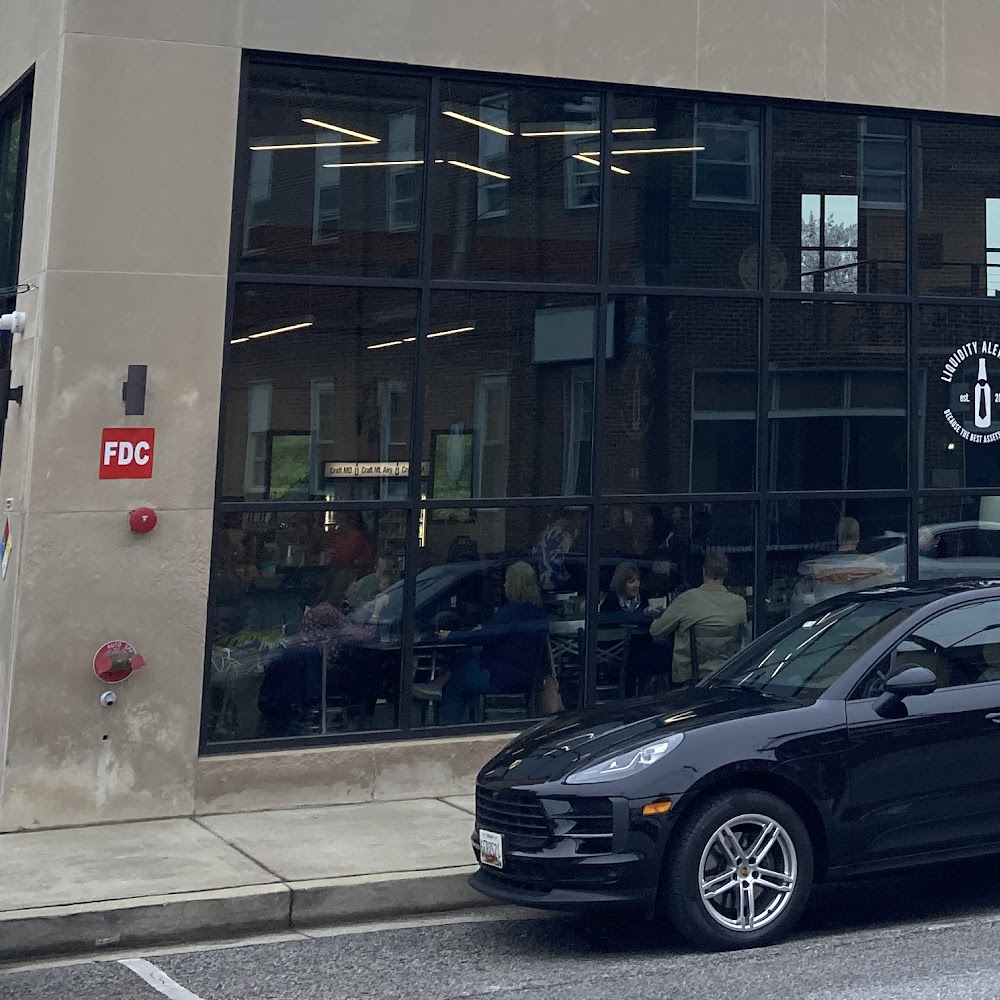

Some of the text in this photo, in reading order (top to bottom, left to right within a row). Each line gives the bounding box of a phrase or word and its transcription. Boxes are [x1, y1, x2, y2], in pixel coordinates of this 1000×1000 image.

[941, 341, 977, 382] LIQUIDITY
[959, 393, 970, 403] est.
[943, 408, 962, 433] BECAUSE
[960, 429, 970, 440] THE
[969, 433, 983, 443] BEST
[103, 441, 150, 466] FDC
[329, 466, 342, 474] Craft
[343, 466, 353, 474] MD
[361, 466, 373, 474] Craft
[382, 466, 393, 475] Airy
